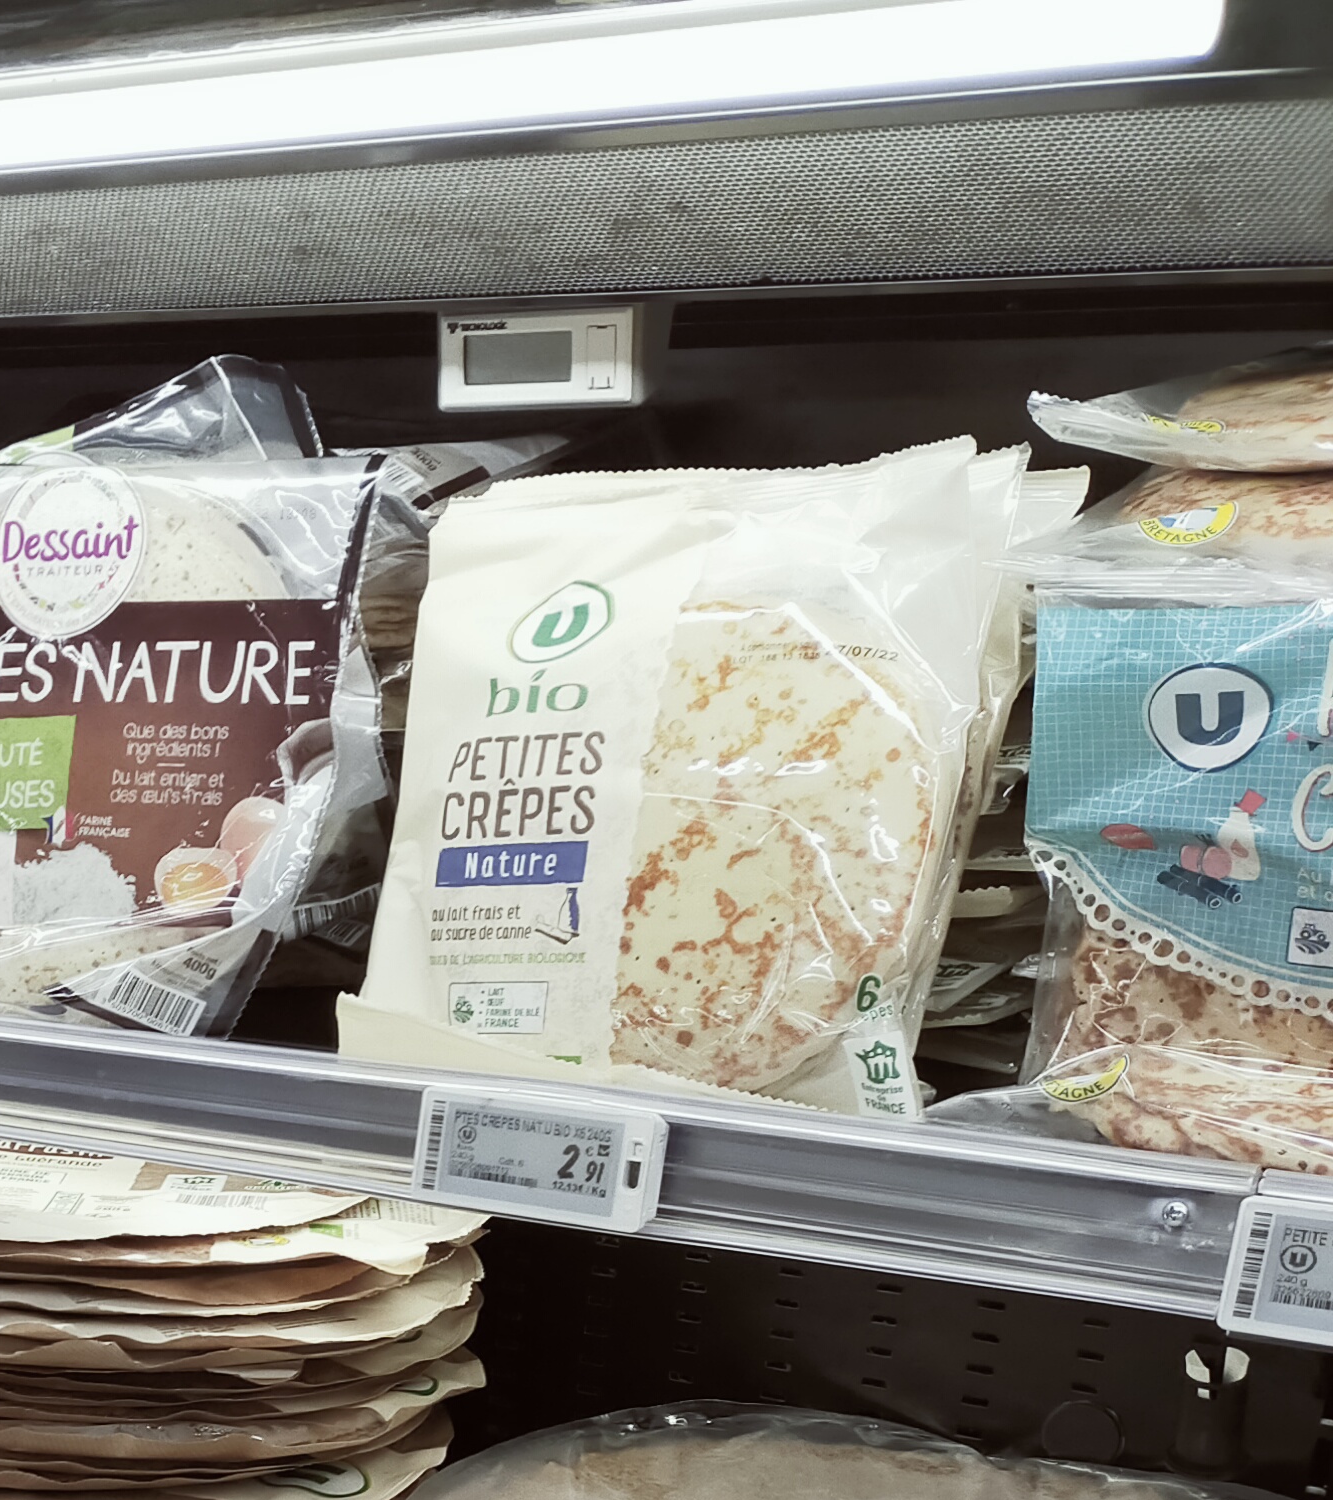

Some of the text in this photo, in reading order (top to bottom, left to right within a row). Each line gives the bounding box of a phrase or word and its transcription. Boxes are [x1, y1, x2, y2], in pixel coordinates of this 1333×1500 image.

[3, 516, 138, 565] Dessaint
[26, 565, 104, 578] TRAITEUR
[533, 602, 590, 648] U
[74, 641, 315, 705] NATURE
[486, 669, 588, 718] bio
[1174, 688, 1246, 746] U
[124, 723, 229, 741] Que des bons
[126, 740, 211, 760] ingrédients
[447, 731, 606, 783] PETITES
[112, 770, 224, 789] Du lait entier et
[441, 778, 596, 841] CRÊPES
[464, 850, 557, 879] Nature
[432, 904, 522, 922] au lait frais et
[429, 924, 533, 941] au sucre de canne
[183, 956, 217, 980] 400g
[856, 974, 883, 1013] 6
[481, 1116, 521, 1131] CREPES
[1283, 1228, 1328, 1246] PETITE
